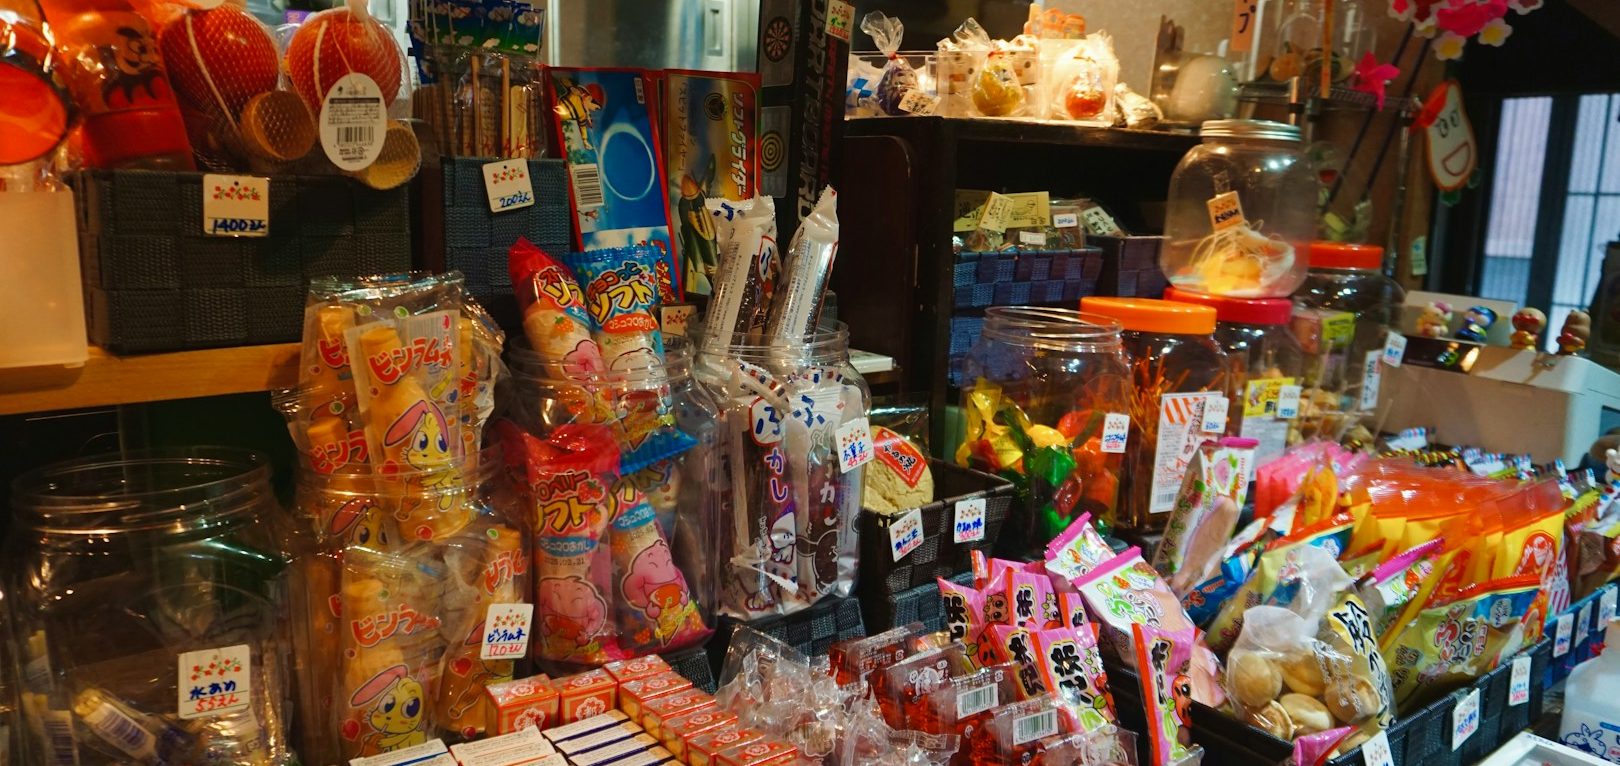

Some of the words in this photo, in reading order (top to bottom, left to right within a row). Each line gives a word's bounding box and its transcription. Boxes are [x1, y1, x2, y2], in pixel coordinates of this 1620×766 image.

[731, 92, 747, 196] ソフトグライダー
[543, 282, 585, 307] ソフ
[588, 280, 654, 325] ソフト
[368, 336, 453, 385] ビンラムネ
[311, 429, 367, 475] ビンラ
[189, 680, 237, 701] 水あめ
